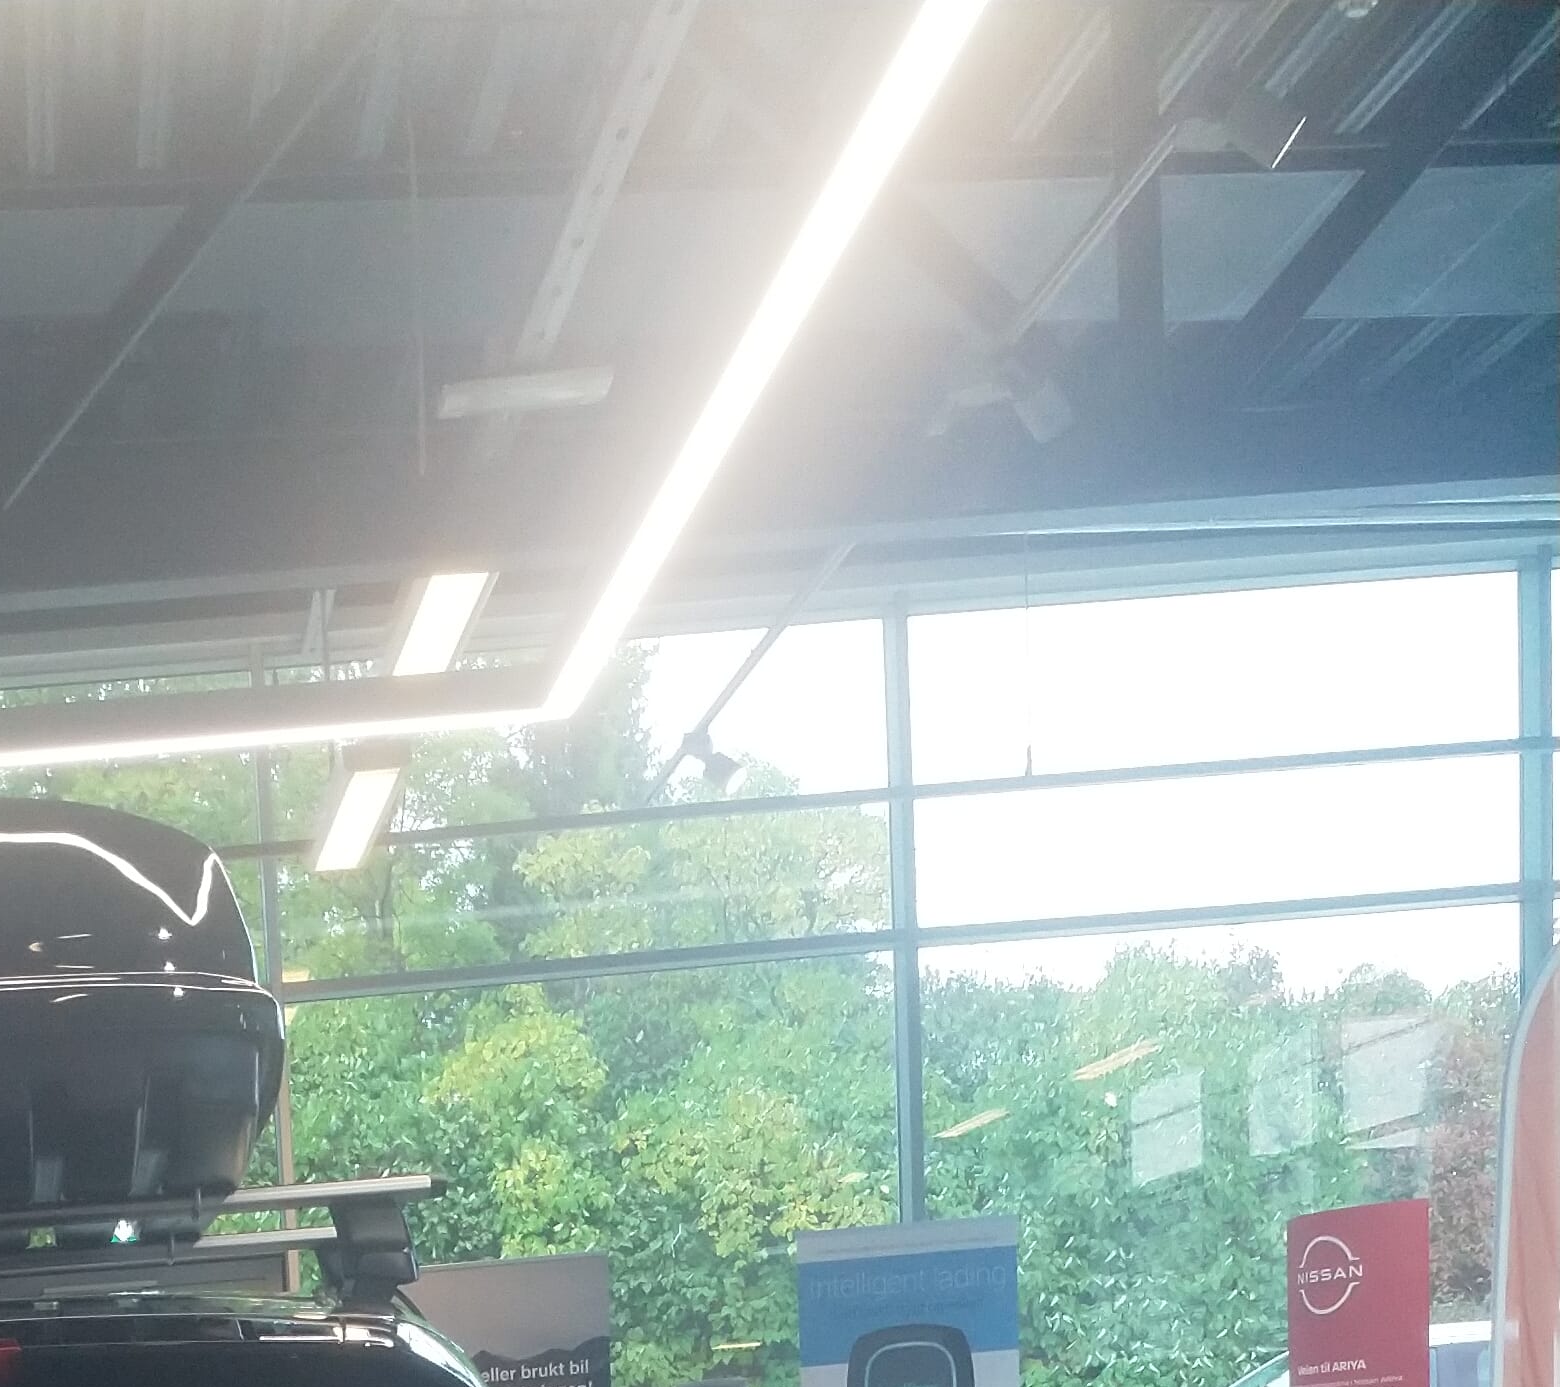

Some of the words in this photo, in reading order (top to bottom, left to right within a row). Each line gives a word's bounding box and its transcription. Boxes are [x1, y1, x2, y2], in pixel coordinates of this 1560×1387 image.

[936, 1264, 1006, 1290] lading
[1298, 1264, 1362, 1284] NISSAN
[521, 1363, 565, 1379] brukt
[570, 1359, 589, 1375] bil
[1321, 1361, 1330, 1373] til
[1332, 1359, 1366, 1373] ARIYA
